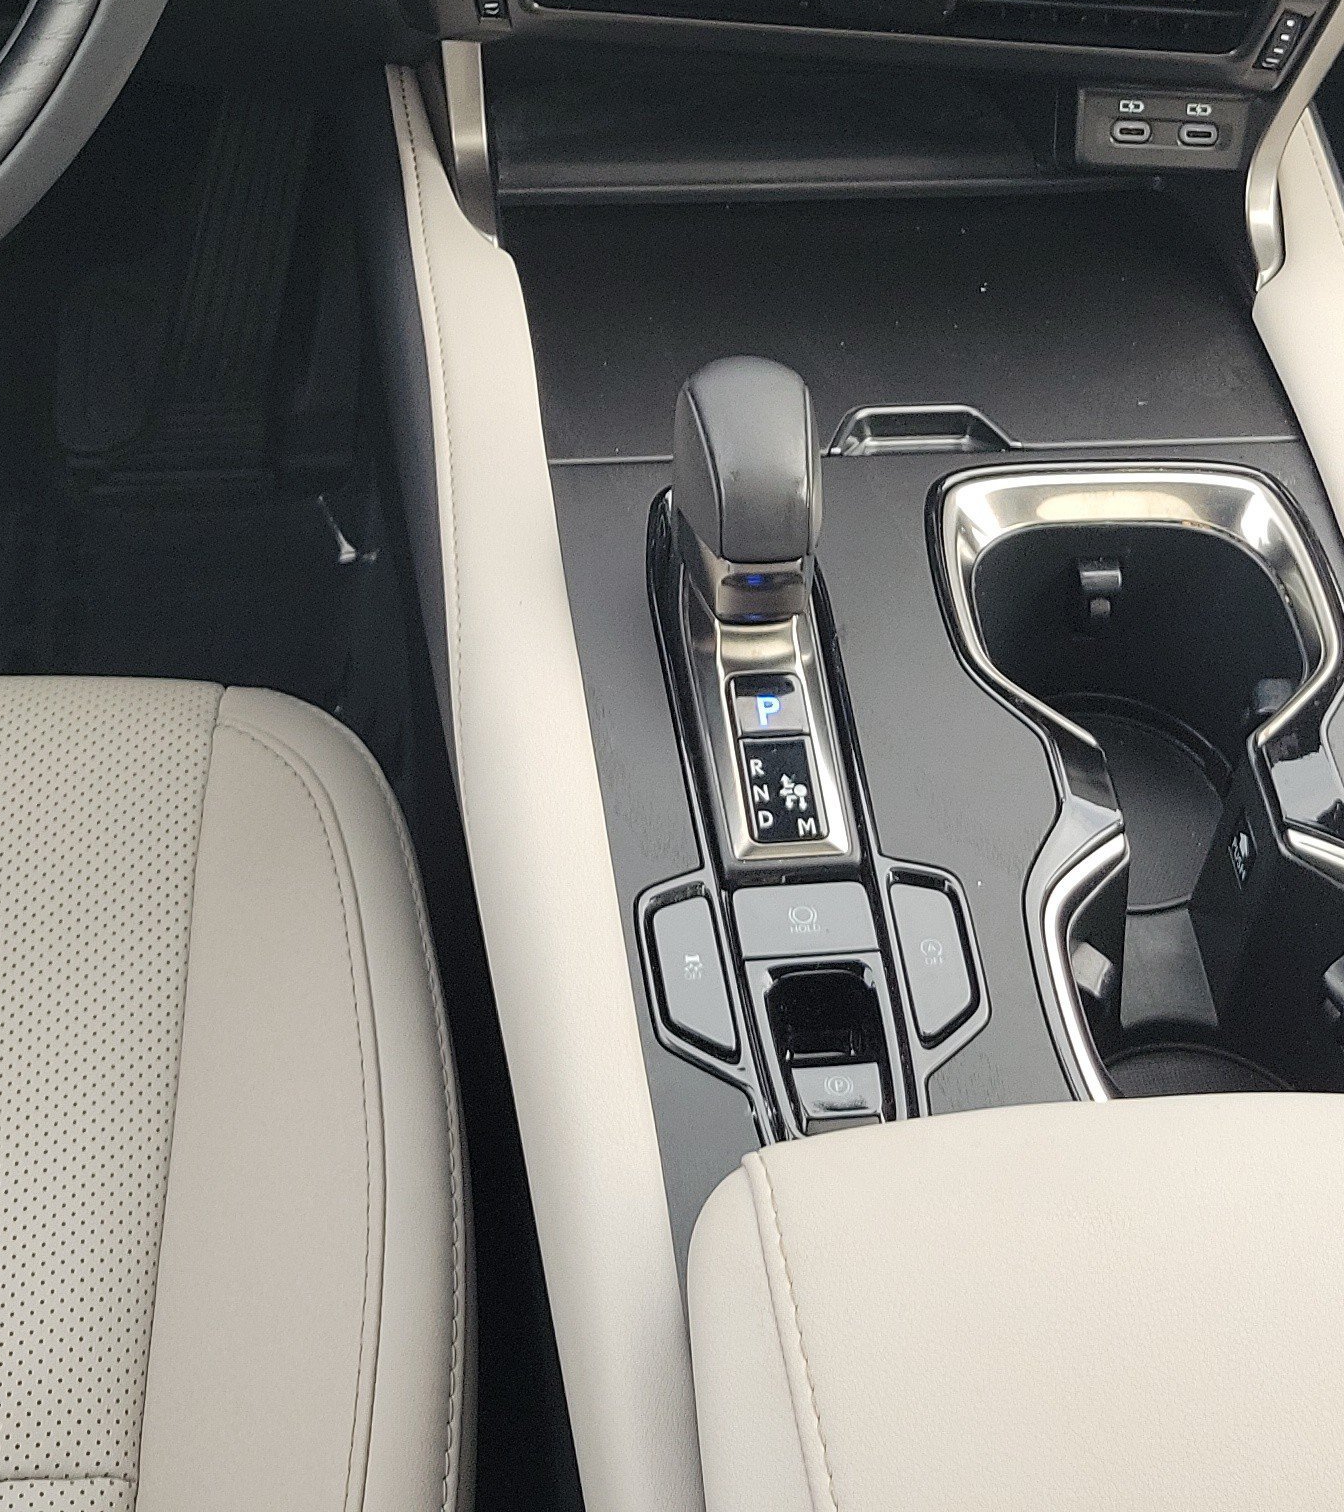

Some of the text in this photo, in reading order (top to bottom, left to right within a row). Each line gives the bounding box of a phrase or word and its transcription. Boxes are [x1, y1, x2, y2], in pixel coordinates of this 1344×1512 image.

[757, 694, 780, 726] P
[749, 758, 765, 777] R
[752, 783, 770, 802] N
[757, 810, 774, 829] D
[797, 817, 817, 838] M
[790, 924, 821, 933] HOLD
